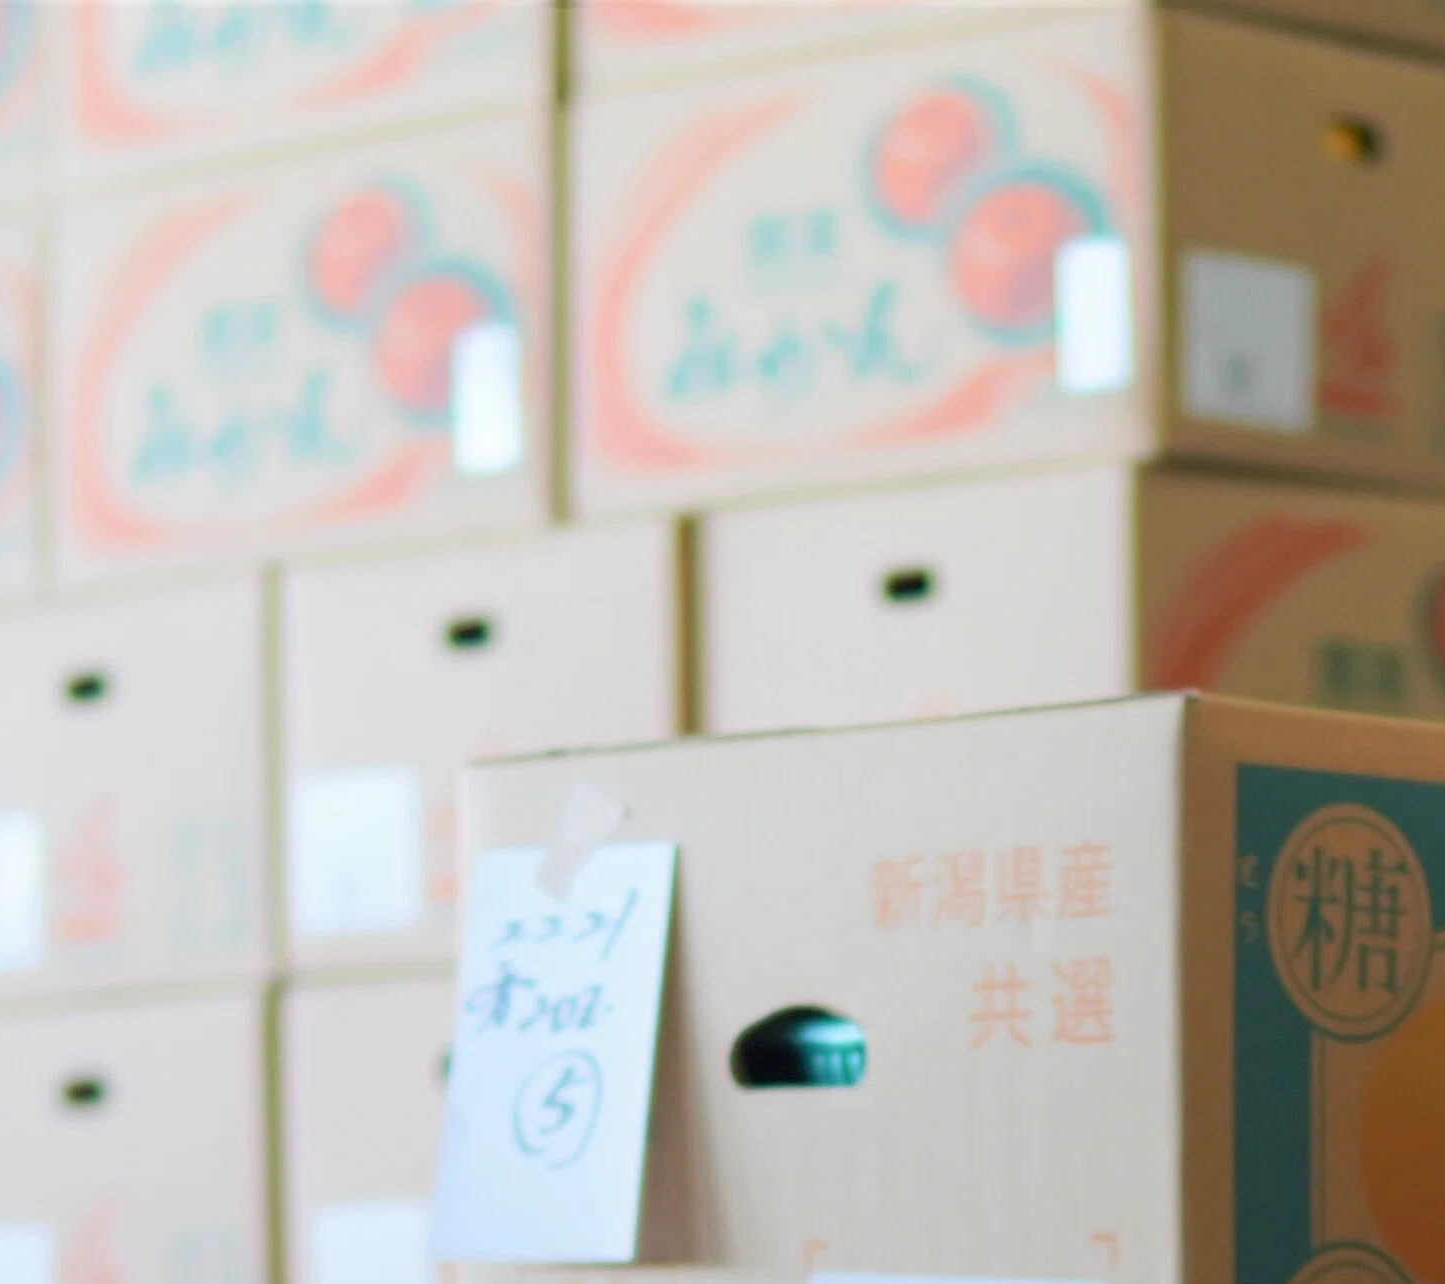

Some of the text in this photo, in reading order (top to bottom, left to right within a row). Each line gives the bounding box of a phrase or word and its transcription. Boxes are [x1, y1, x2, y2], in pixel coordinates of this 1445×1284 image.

[871, 842, 1113, 932] 新潟県産
[1290, 847, 1411, 998] 糖
[970, 956, 1117, 1049] 共選
